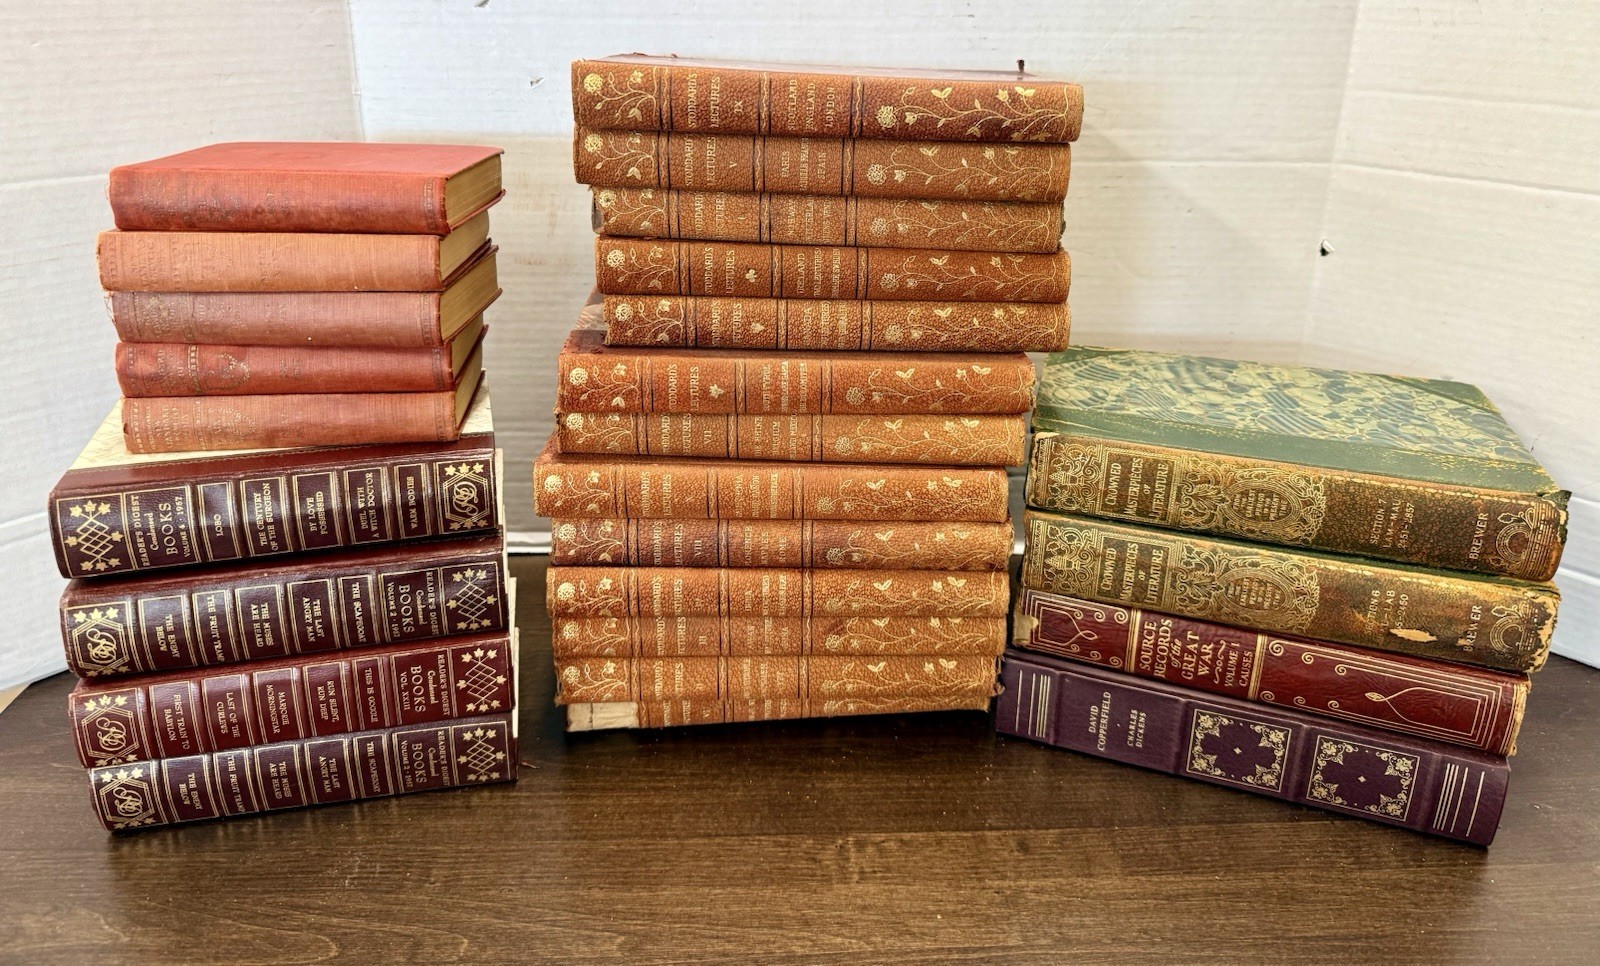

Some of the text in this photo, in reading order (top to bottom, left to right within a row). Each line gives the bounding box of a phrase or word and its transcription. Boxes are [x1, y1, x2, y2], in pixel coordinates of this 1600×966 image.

[688, 73, 697, 127] STODDARD'S
[711, 77, 720, 127] LECTURES
[788, 79, 798, 131] SCOTLAND
[806, 83, 816, 129] ENGLAND
[826, 87, 835, 127] LONDON
[818, 152, 826, 179] SPAIN
[797, 253, 805, 294] IRELAND
[366, 472, 375, 507] DOCTOR
[407, 476, 418, 529] WARM BODIES
[1105, 463, 1121, 505] CROWNED
[1124, 458, 1143, 515] MASTERPIECES
[1144, 484, 1150, 494] OF
[1150, 464, 1169, 518] LITERATURE
[214, 514, 223, 536] LOBO
[254, 492, 267, 546] THE CENTURY
[263, 483, 278, 551] OF THE SURGEON
[307, 497, 317, 531] BY LOVE
[316, 491, 328, 534] POSSESSED
[357, 487, 368, 529] DUEL WITH
[369, 510, 378, 530] WITCH
[1370, 509, 1386, 544] SECTION
[131, 495, 151, 566] READER'S DIGEST
[145, 512, 159, 550] Condensed
[159, 502, 178, 555] BOOKS
[180, 531, 191, 557] VOLUME
[1469, 513, 1489, 559] BREWER
[1101, 548, 1116, 590] CROWNED
[1120, 543, 1138, 599] MASTERPIECES
[1138, 570, 1145, 580] OF
[1145, 549, 1163, 603] LITERATURE
[352, 583, 360, 599] THE
[387, 582, 397, 611] VOLUME
[399, 585, 414, 633] BOOKS
[416, 590, 427, 625] Condensed
[426, 572, 439, 635] READER'S DIGEST
[165, 614, 180, 658] THE ENEMY
[207, 595, 225, 662] THE FRUIT TRAMP
[251, 604, 263, 647] ARE HEARD
[261, 602, 273, 646] THE MUSES
[303, 597, 315, 642] ANGRY MAN
[313, 599, 325, 637] THE LAST
[1463, 605, 1482, 651] BREWER
[156, 626, 167, 651] BELOW
[1140, 621, 1157, 670] SOURCE
[1154, 619, 1172, 677] RECORDS
[1169, 638, 1182, 667] of the
[1182, 631, 1199, 680] GREAT
[364, 668, 373, 684] THIS
[1198, 643, 1213, 675] WAR
[1224, 650, 1239, 687] VOLUME
[1240, 651, 1253, 686] CAUSES
[327, 680, 335, 696] RUN
[400, 671, 408, 689] VOL.
[411, 666, 426, 713] BOOKS
[428, 670, 438, 704] Condensed
[438, 654, 450, 716] READER'S DIGEST
[174, 694, 190, 750] FIRST TRAIN TO
[216, 702, 228, 734] CURLEWS
[226, 692, 240, 737] LAST OF THE
[266, 685, 280, 734] MORNINGSTAR
[278, 692, 289, 725] MARJORIE
[317, 686, 328, 720] RUN DEEP
[1089, 706, 1098, 733] DAVID
[1098, 692, 1111, 751] COPPERFIELD
[164, 709, 177, 741] BABYLON
[1127, 709, 1137, 746] CHARLES
[1136, 712, 1146, 747] DICKENS
[227, 755, 236, 771] THE
[366, 741, 375, 756] THE
[400, 740, 410, 764] VOLUME
[412, 743, 427, 783] BOOKS
[438, 730, 450, 786] READER'S DIGEST
[188, 773, 196, 788] THE
[230, 774, 240, 793] FRUIT
[270, 763, 282, 799] ARE HEARD
[279, 762, 292, 797] THE MUSES
[319, 756, 332, 793] ANGRY MAN
[329, 759, 340, 788] THE LAST
[179, 783, 190, 805] BELOW
